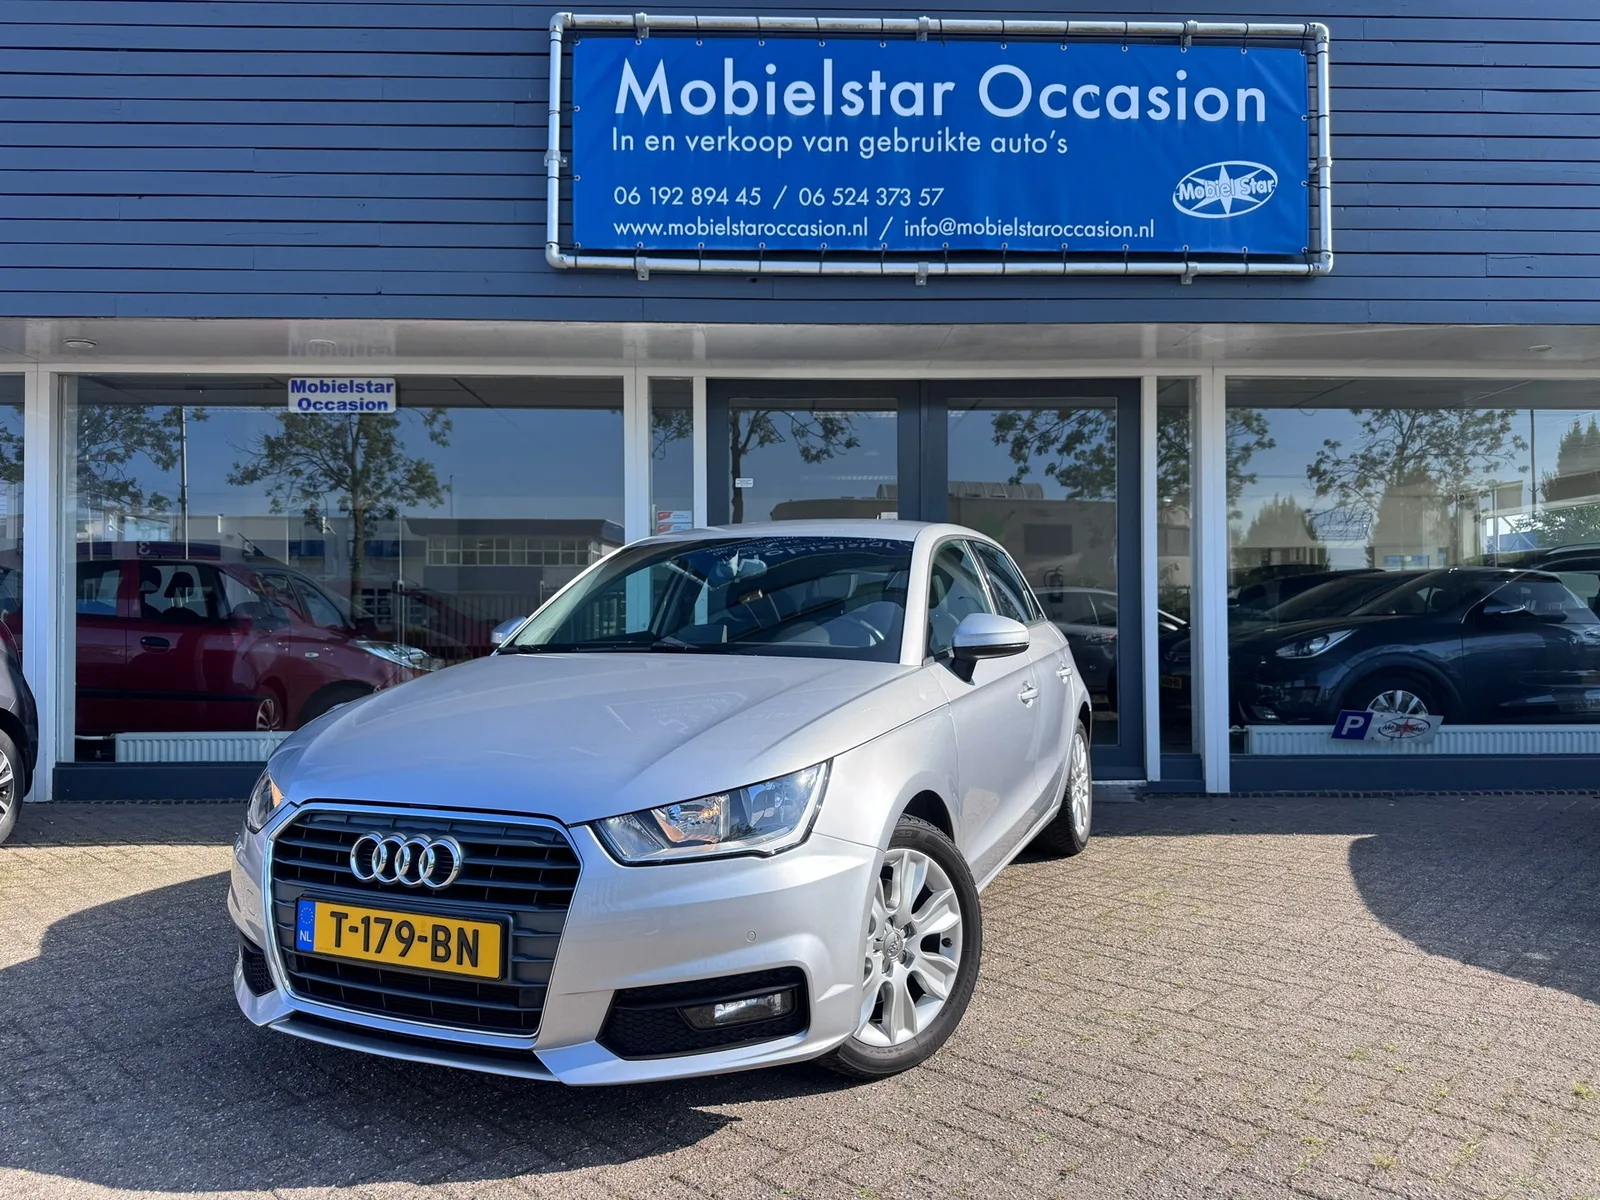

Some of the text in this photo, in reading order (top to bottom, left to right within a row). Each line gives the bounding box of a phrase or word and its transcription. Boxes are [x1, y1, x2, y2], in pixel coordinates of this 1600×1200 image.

[614, 57, 1266, 122] Mobielstar Occasion
[613, 126, 634, 151] In
[644, 134, 675, 151] en
[685, 125, 793, 159] verkoop
[802, 135, 849, 152] van
[859, 126, 981, 159] gebruikte
[613, 186, 641, 206] 06
[650, 186, 684, 206] 192
[691, 186, 729, 206] 894
[735, 186, 762, 206] 45
[799, 187, 825, 206] 06
[831, 187, 870, 206] 524
[876, 187, 911, 207] 373
[918, 187, 945, 207] 57
[1178, 177, 1275, 201] Mobiel Star
[613, 216, 868, 237] www.mobielstaroccasion.nl
[905, 216, 1154, 238] info@mobielstaroccasion.nl
[290, 379, 394, 394] Mobielstar
[297, 397, 389, 412] Occasion
[1341, 715, 1365, 736] P
[299, 929, 313, 943] NL
[329, 910, 480, 968] T-179-BN
